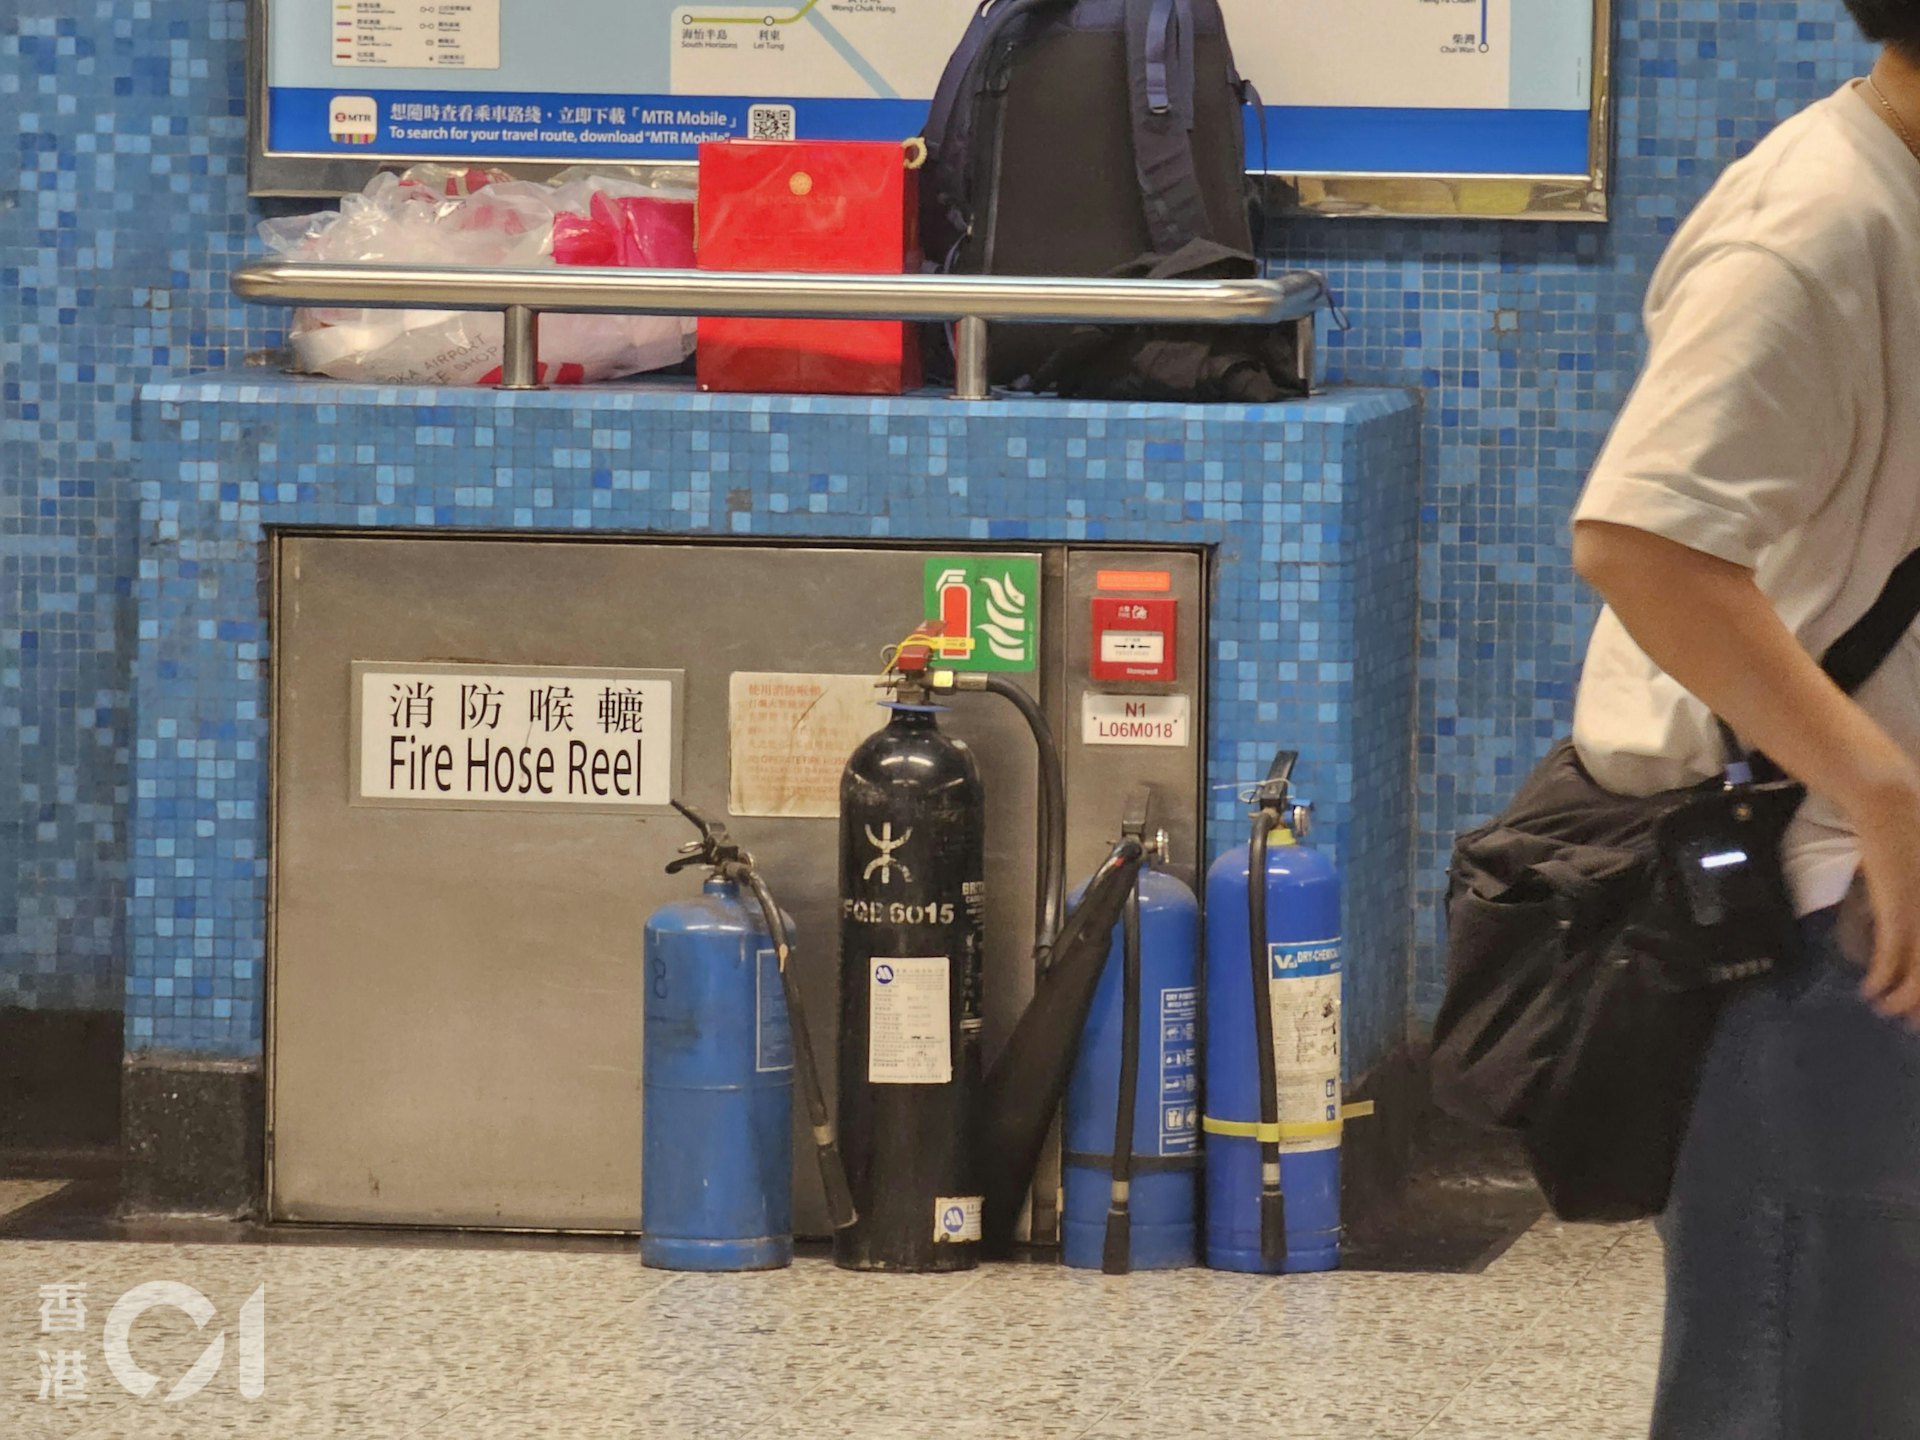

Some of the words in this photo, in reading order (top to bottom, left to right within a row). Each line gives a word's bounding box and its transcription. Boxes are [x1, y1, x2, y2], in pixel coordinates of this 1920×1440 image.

[348, 114, 371, 122] MTR
[389, 126, 405, 139] To
[407, 127, 448, 139] search
[450, 127, 468, 140] for
[471, 130, 499, 143] your
[502, 129, 538, 142] travel
[541, 130, 577, 143] route,
[580, 129, 643, 143] download
[424, 333, 485, 370] AIRPORT
[390, 682, 643, 734] 消防喉轆
[1126, 703, 1146, 717] N1
[1099, 722, 1172, 738] L06M018
[390, 735, 453, 791] Fire
[467, 738, 554, 794] Hose
[568, 739, 642, 796] Reel
[890, 902, 954, 924] 6015
